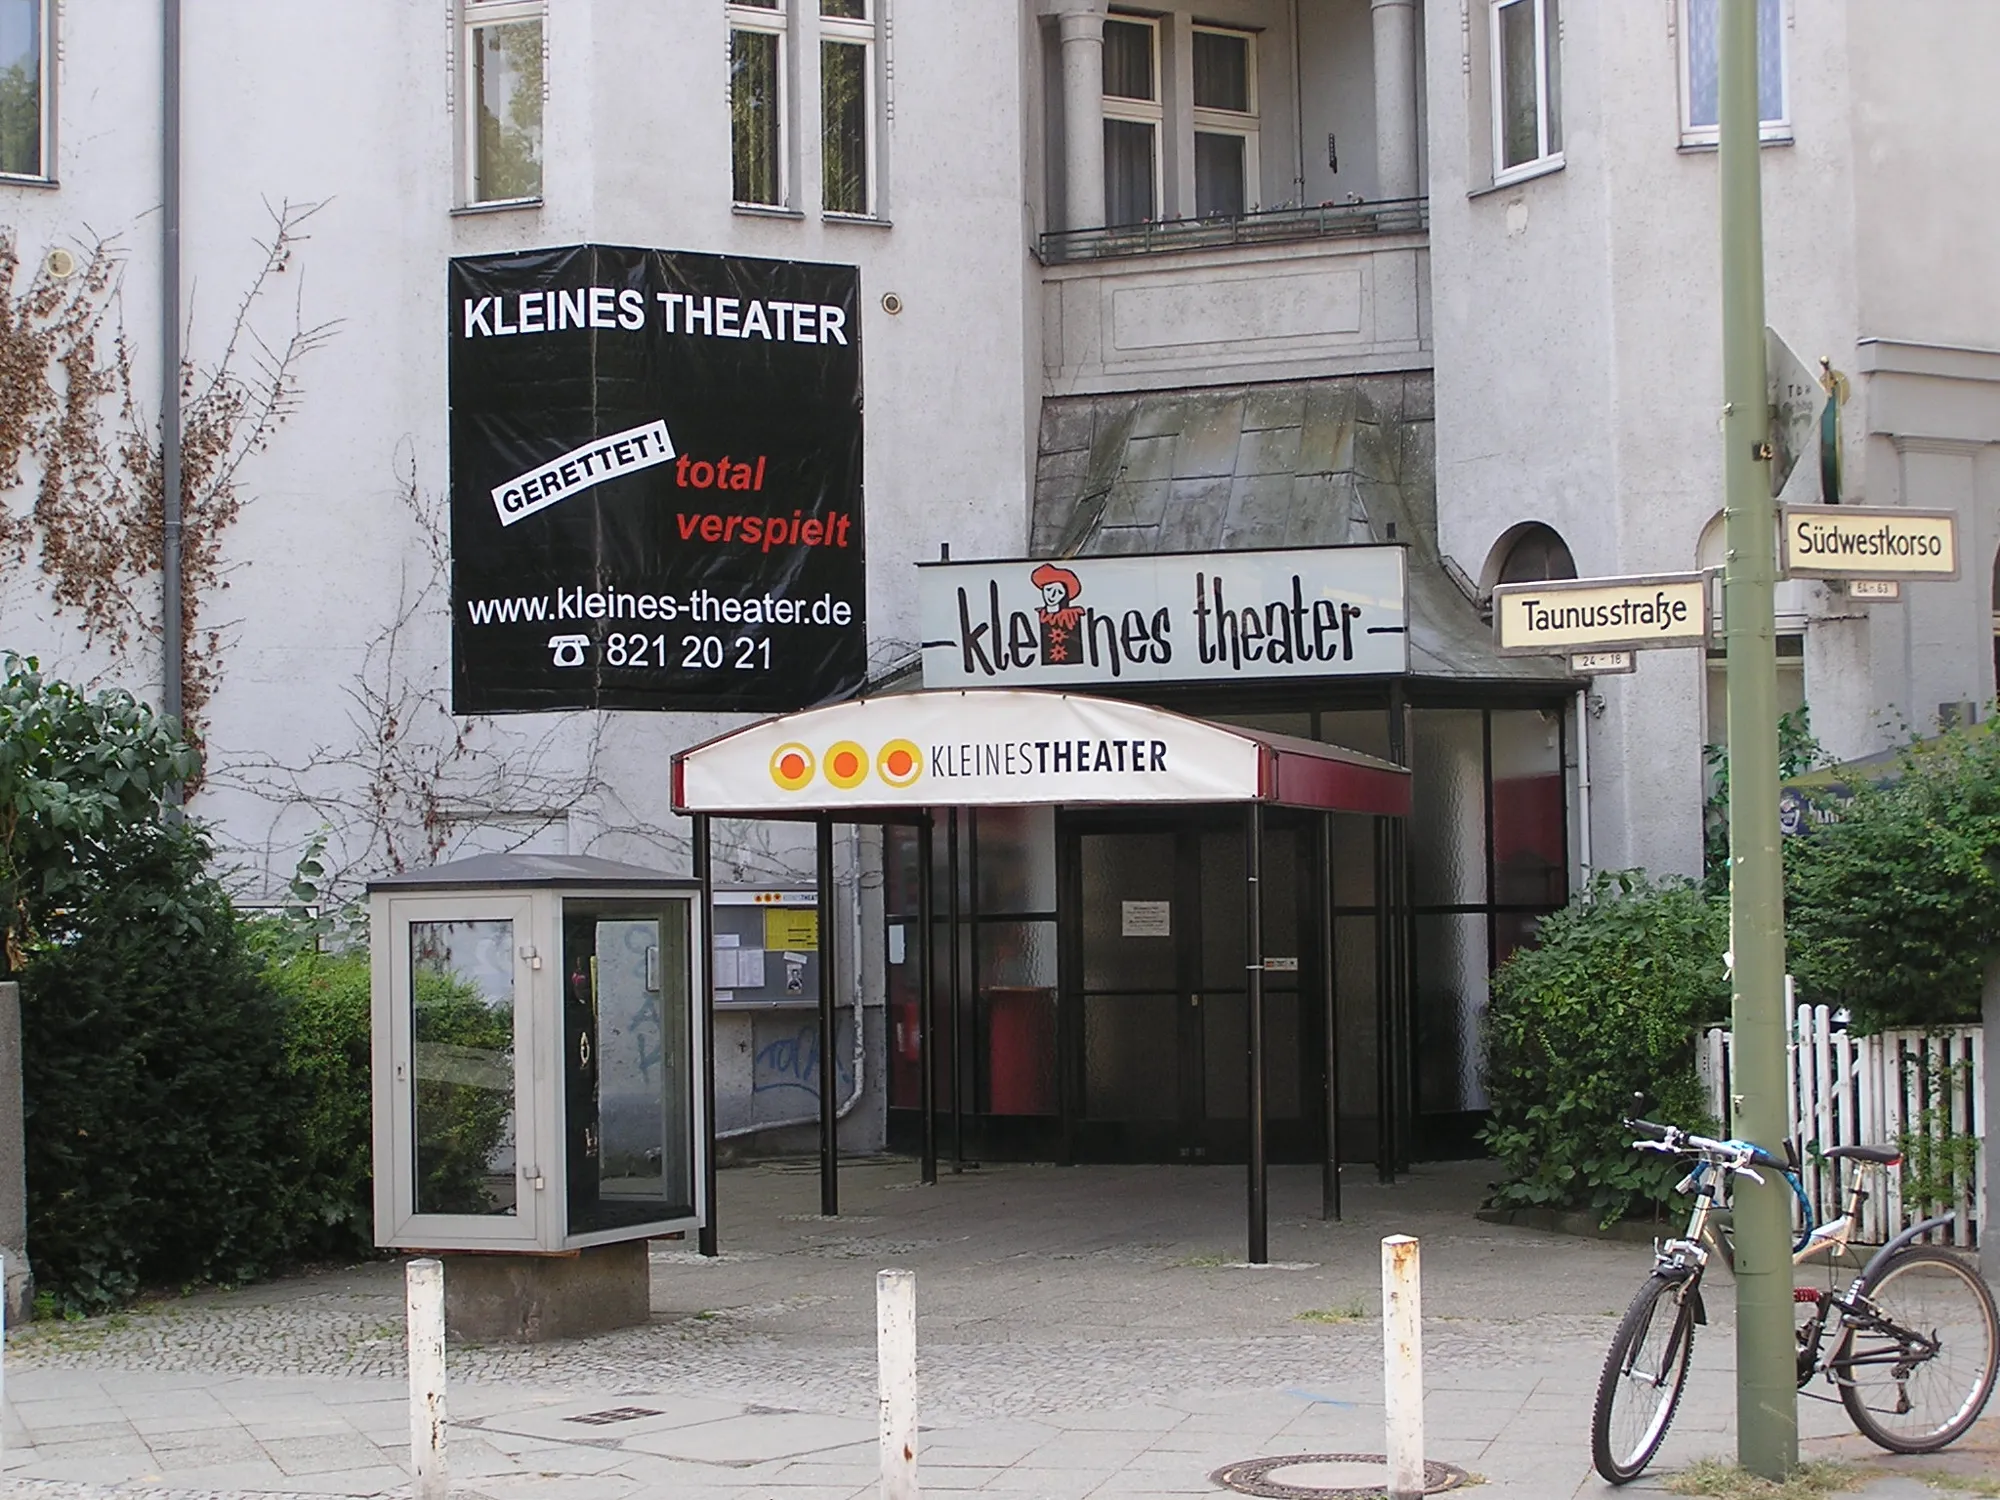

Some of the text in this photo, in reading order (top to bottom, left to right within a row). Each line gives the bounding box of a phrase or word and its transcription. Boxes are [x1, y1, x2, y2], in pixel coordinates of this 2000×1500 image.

[464, 287, 848, 345] KLEINES THEATER
[502, 430, 665, 513] GERETTET!
[676, 453, 766, 492] total
[676, 510, 851, 552] verspielt
[1797, 521, 1942, 556] Südwestkorso
[467, 586, 852, 625] www.kleines-theater.de
[1194, 572, 1362, 669] theater
[1522, 591, 1688, 632] Taunusstraße
[606, 633, 771, 669] 821 20 21
[1610, 653, 1622, 665] 18
